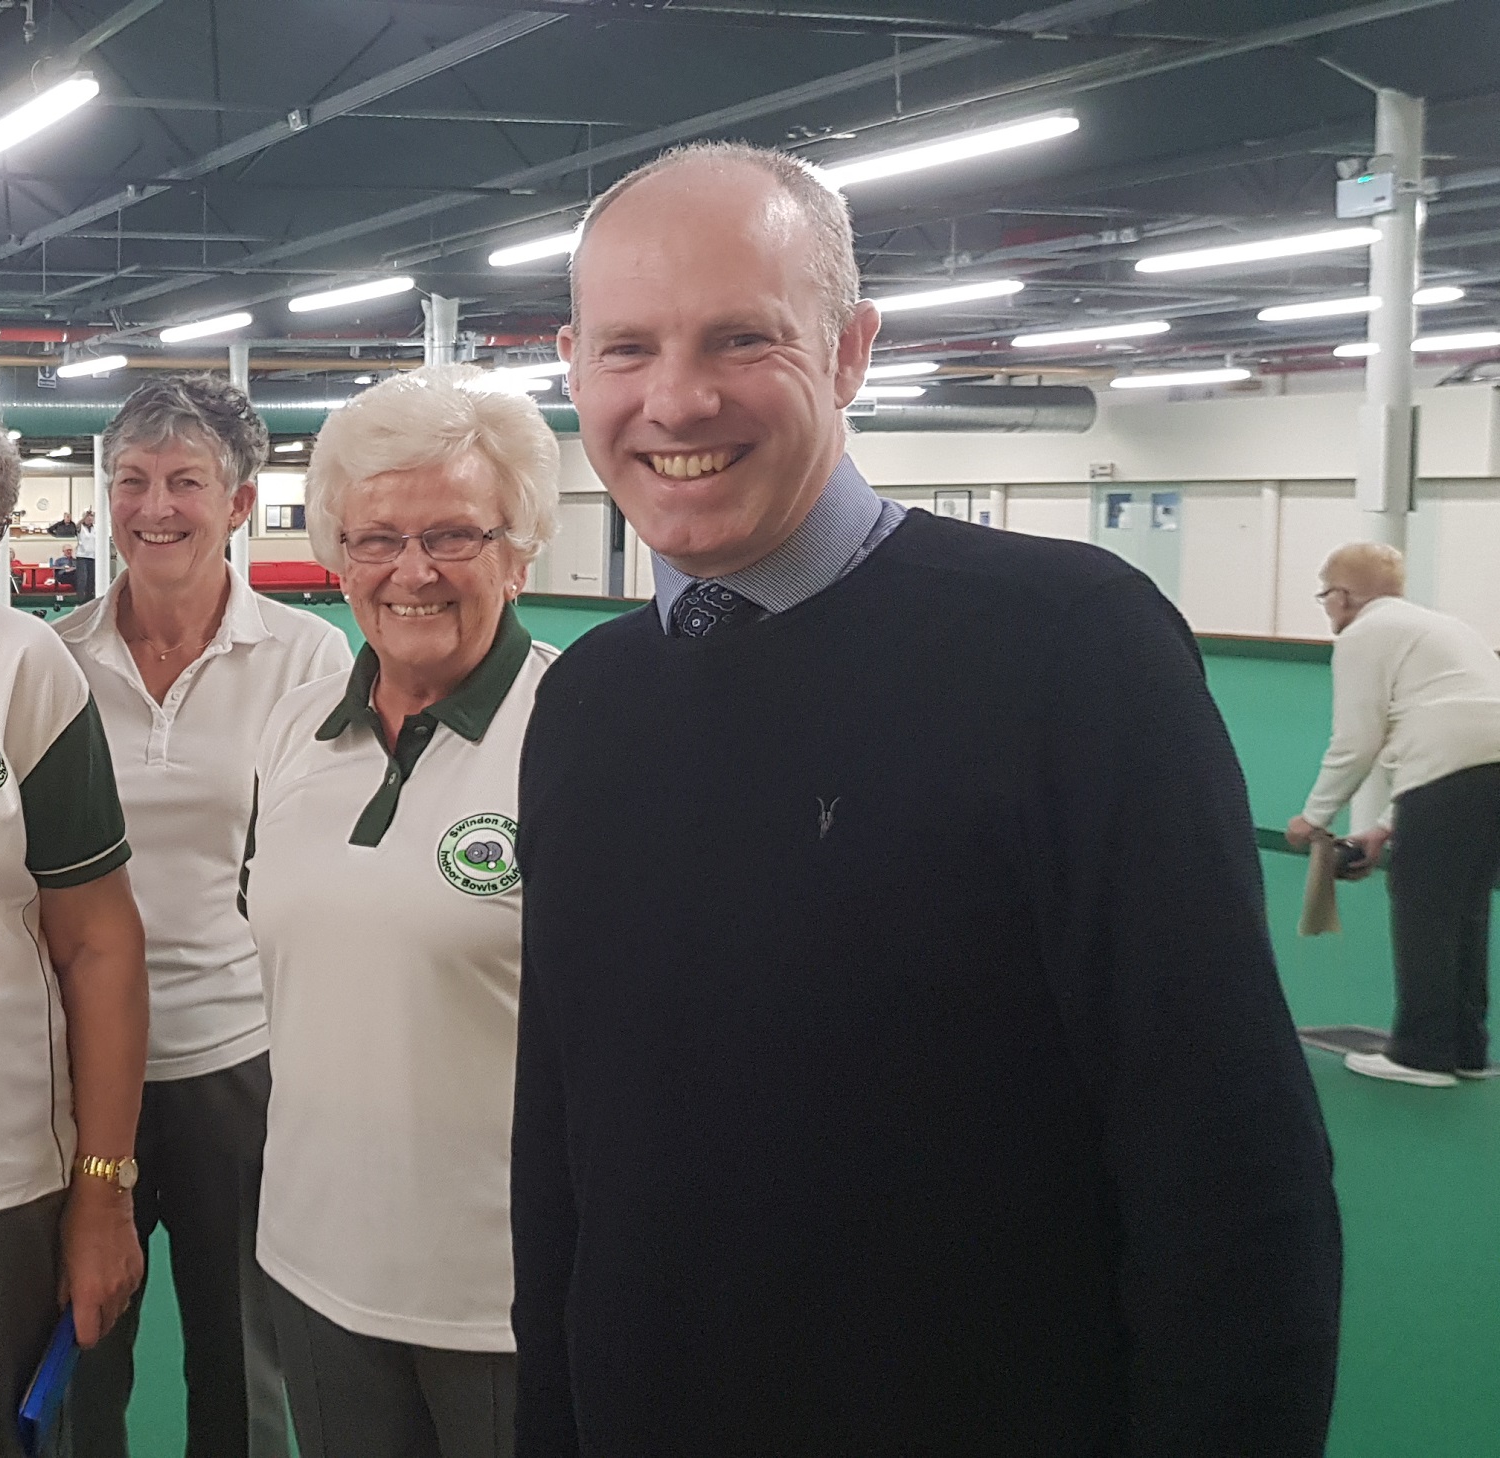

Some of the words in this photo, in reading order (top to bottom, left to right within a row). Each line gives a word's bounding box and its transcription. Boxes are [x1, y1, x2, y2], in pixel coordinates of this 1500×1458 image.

[449, 816, 499, 838] Swindon
[501, 820, 518, 838] Ma
[440, 851, 461, 881] Indoor
[460, 879, 498, 892] Bowls
